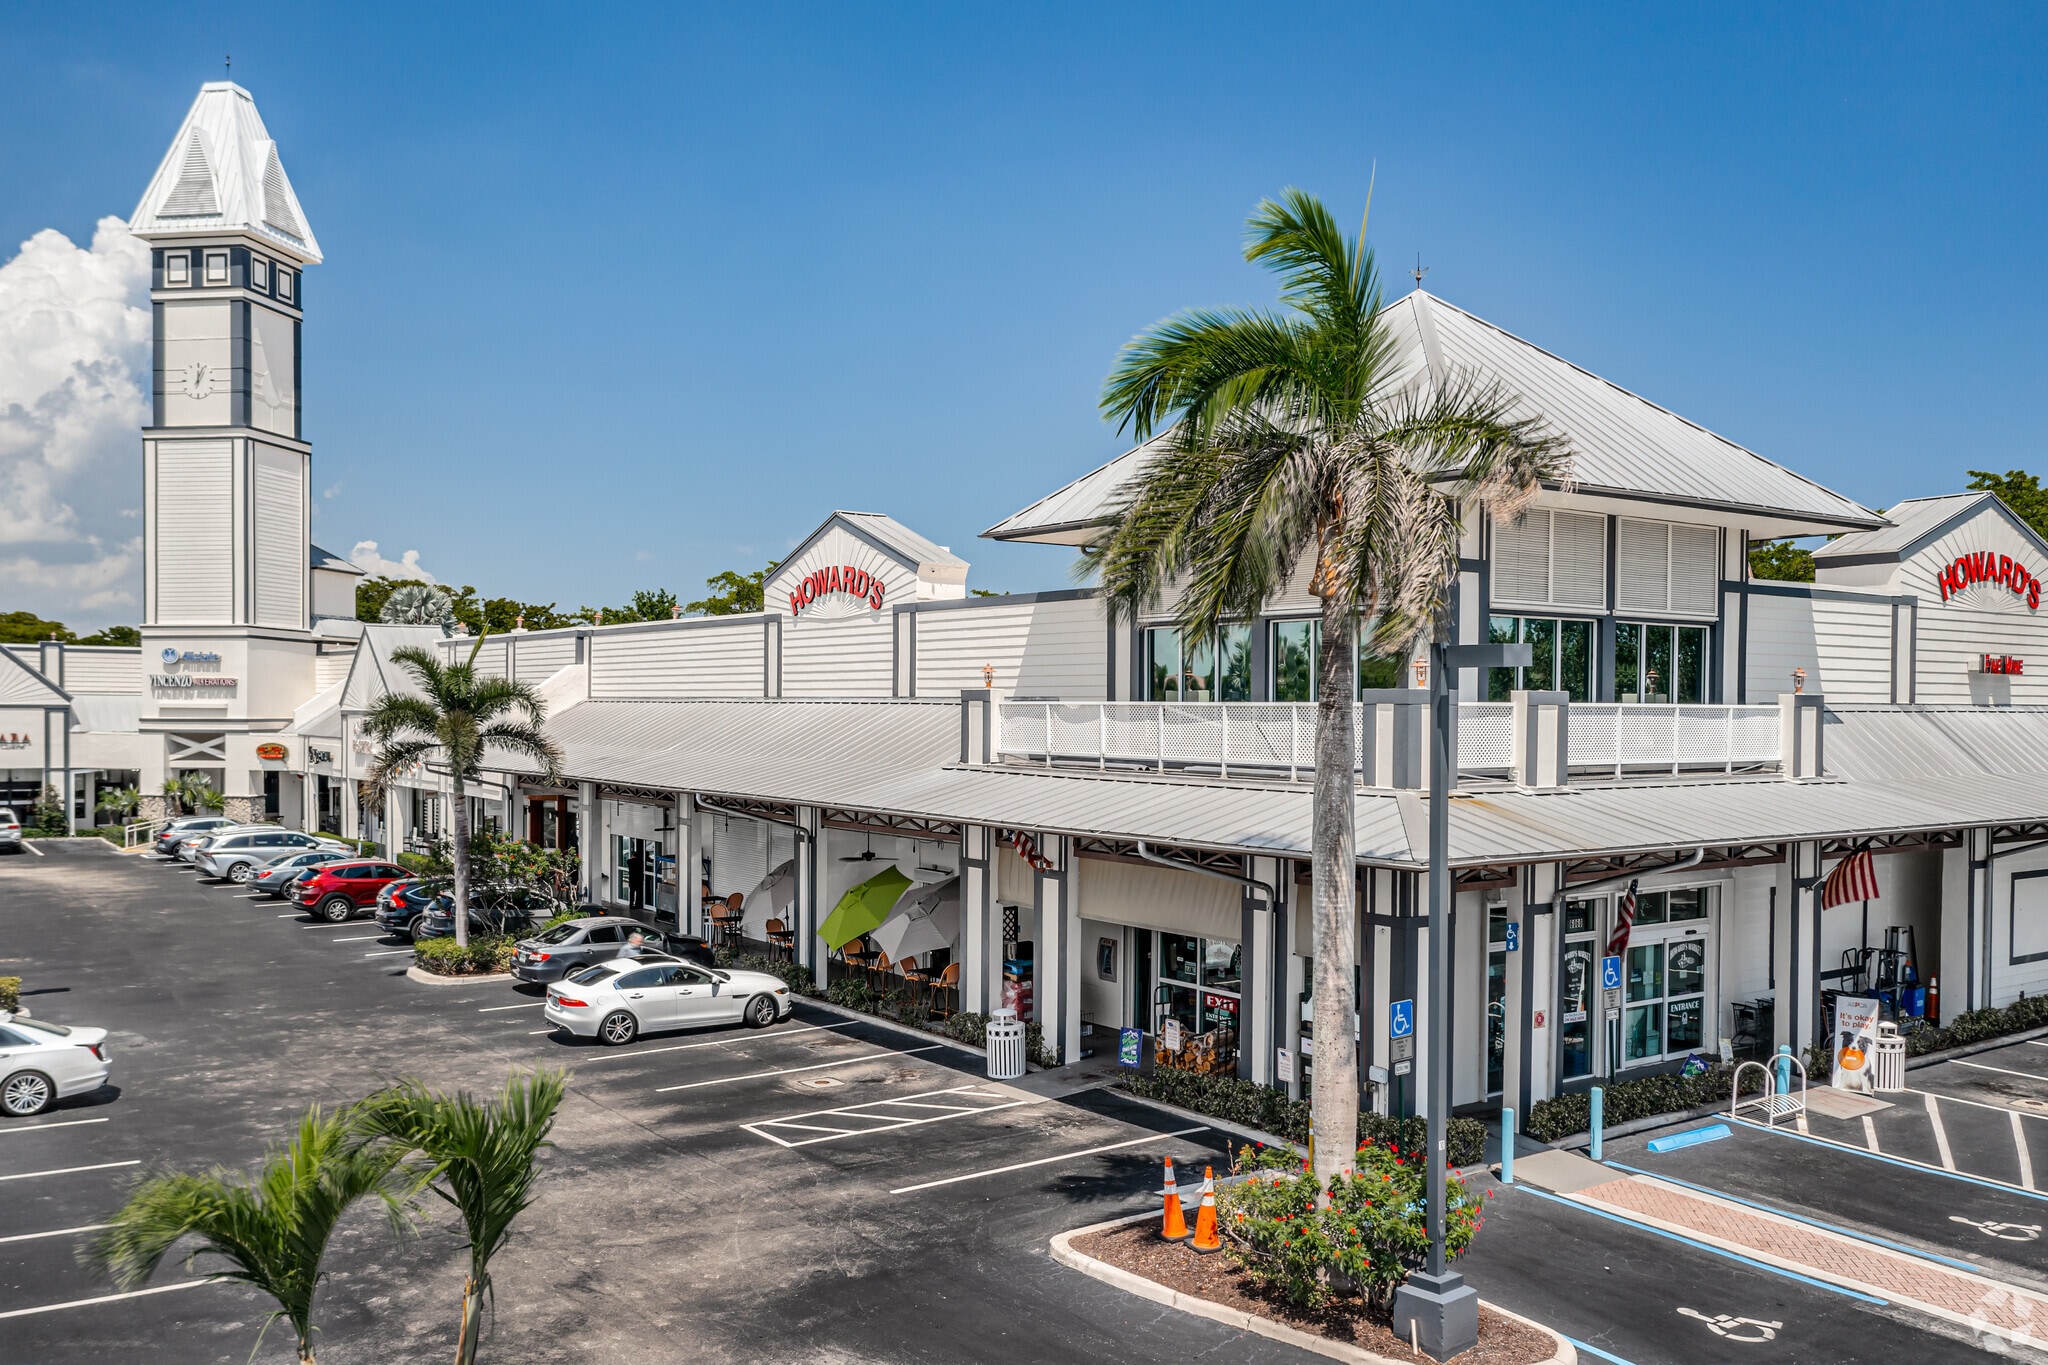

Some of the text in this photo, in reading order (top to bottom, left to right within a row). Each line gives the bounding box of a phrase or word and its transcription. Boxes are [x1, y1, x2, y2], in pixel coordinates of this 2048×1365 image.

[1937, 551, 2042, 610] HOWARD'S
[789, 565, 885, 616] HOWARD'S
[149, 674, 238, 687] VINCENZO ALTERATIONS
[1206, 995, 1234, 1011] EXIT
[1670, 1000, 1700, 1013] ENTRANCE
[1840, 1012, 1874, 1023] It's okay
